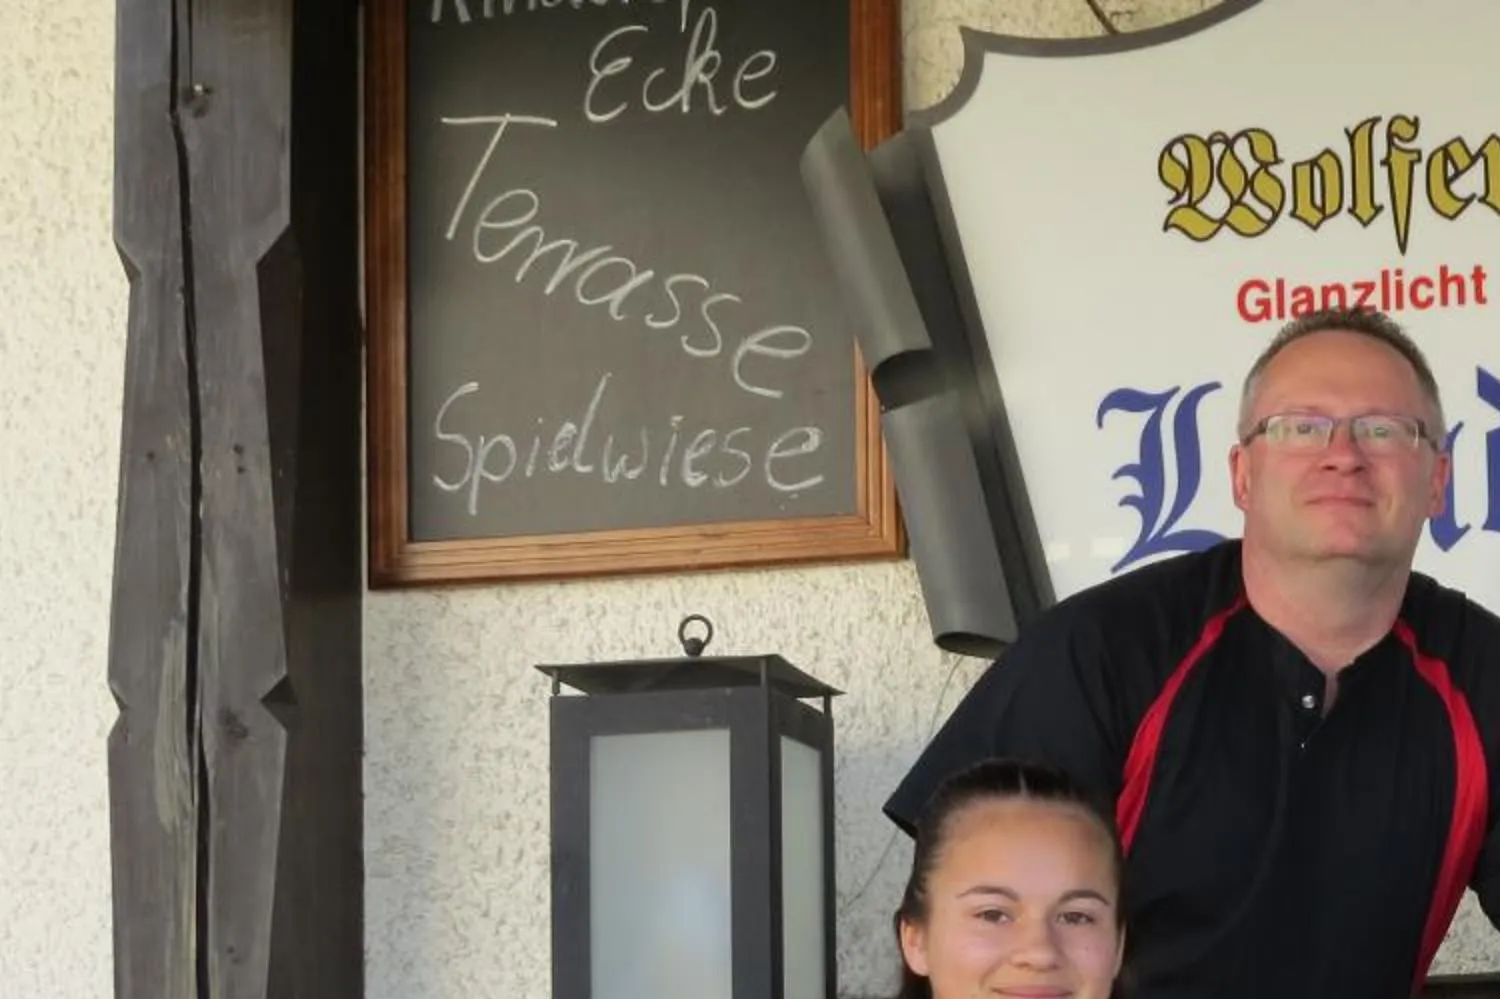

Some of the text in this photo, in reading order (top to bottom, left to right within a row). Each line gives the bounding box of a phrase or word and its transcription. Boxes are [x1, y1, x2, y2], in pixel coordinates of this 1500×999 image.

[584, 6, 778, 122] Ecke
[441, 113, 813, 398] Terrasse
[1236, 266, 1488, 323] Glanzlicht
[432, 373, 825, 515] Spielwiese
